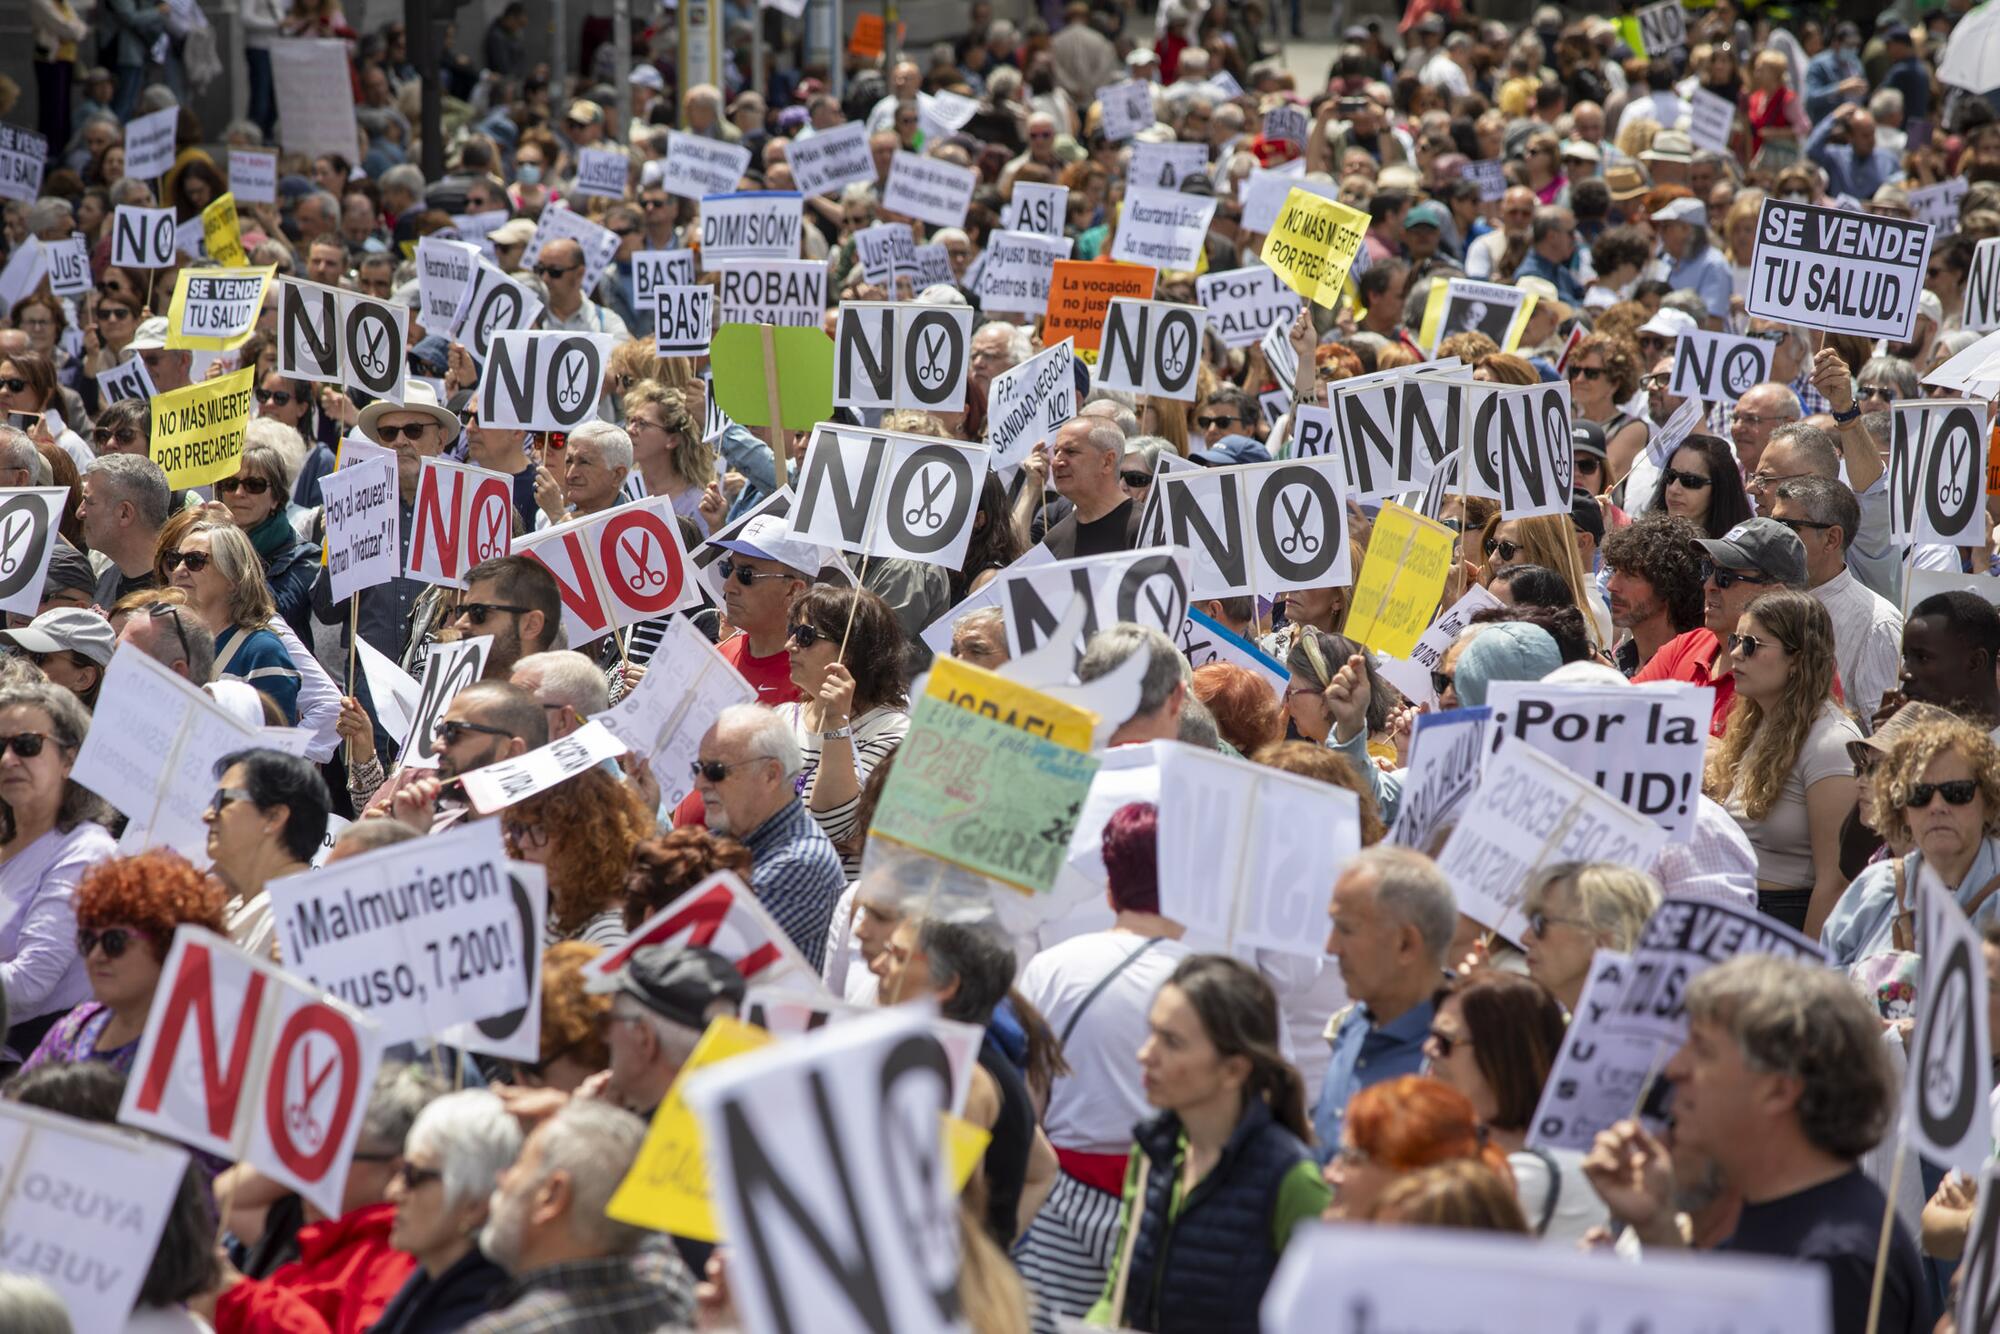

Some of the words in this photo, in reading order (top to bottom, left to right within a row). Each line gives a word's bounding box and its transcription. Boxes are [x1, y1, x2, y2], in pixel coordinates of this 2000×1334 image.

[1640, 5, 1680, 49] NO
[116, 213, 175, 264] NO
[704, 206, 798, 247] DIMISIÓN!
[1283, 207, 1304, 235] NO
[1301, 211, 1326, 242] MÁS
[1764, 207, 1807, 245] SE
[1817, 214, 1925, 266] VENDE
[1271, 239, 1298, 271] POR
[189, 279, 209, 299] SE
[214, 278, 261, 300] VENDE
[723, 271, 821, 307] ROBAN
[985, 273, 1027, 297] Centros
[1063, 277, 1078, 290] La
[1083, 278, 1141, 294] vocación
[1063, 299, 1080, 309] no
[1201, 276, 1262, 308] ¡Por
[1763, 256, 1801, 308] TU
[1804, 263, 1904, 323] SALUD.
[189, 304, 208, 328] TU
[283, 282, 401, 394] NO
[1050, 314, 1060, 328] la
[839, 308, 964, 404] NO
[1099, 303, 1198, 392] NO
[1674, 335, 1766, 400] NO
[483, 337, 601, 426] NO
[992, 342, 1070, 454] SANIDAD-NEGOCIO
[1048, 388, 1069, 424] NO!
[158, 411, 177, 437] NO
[180, 400, 207, 433] MÁS
[157, 445, 182, 473] POR
[1500, 388, 1571, 512] NO
[1890, 407, 1982, 537] NO
[325, 493, 346, 531] Hoy,
[345, 484, 354, 518] al
[793, 431, 974, 554] NO
[412, 465, 512, 579] NO
[1167, 465, 1341, 588] NO
[517, 509, 684, 632] NO
[1008, 554, 1188, 682] NO
[1411, 642, 1429, 658] no
[1492, 699, 1626, 754] ¡Por
[1649, 703, 1699, 745] la
[285, 860, 500, 965] ¡Malmurieron
[1648, 903, 1692, 948] SE
[425, 920, 517, 995] 7,200!
[136, 943, 361, 1184] NO
[724, 1033, 956, 1334] NO
